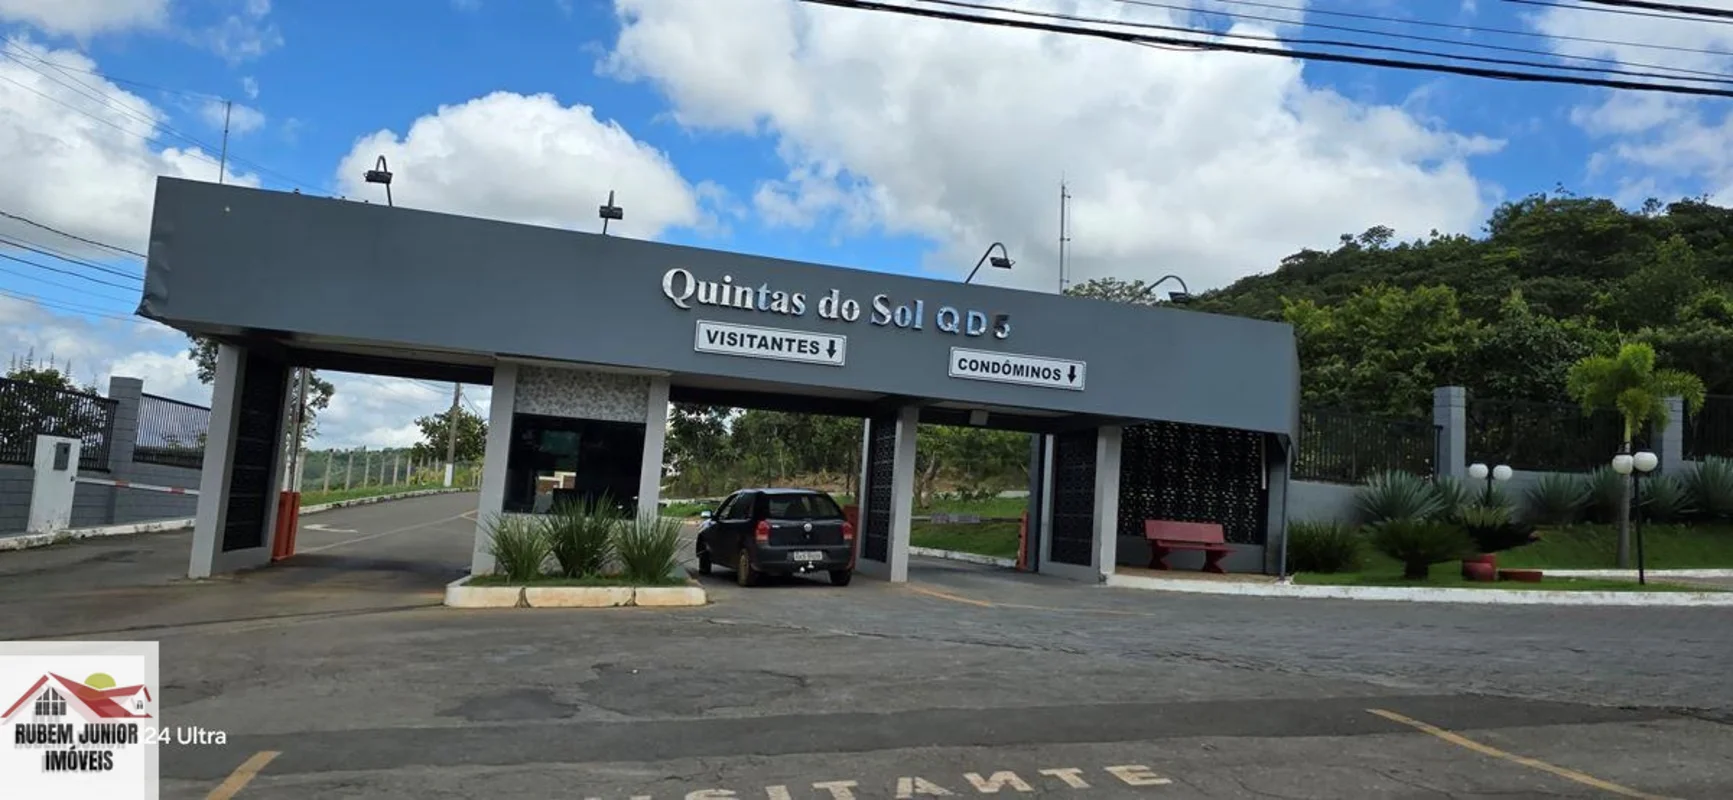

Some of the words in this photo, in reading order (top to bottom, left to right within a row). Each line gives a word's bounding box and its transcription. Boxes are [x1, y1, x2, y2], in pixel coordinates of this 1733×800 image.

[662, 267, 807, 316] Quintas
[818, 288, 860, 322] do
[870, 293, 924, 330] Sol
[706, 329, 820, 355] VISITANTES
[958, 357, 1062, 381] CONDÔMINOS
